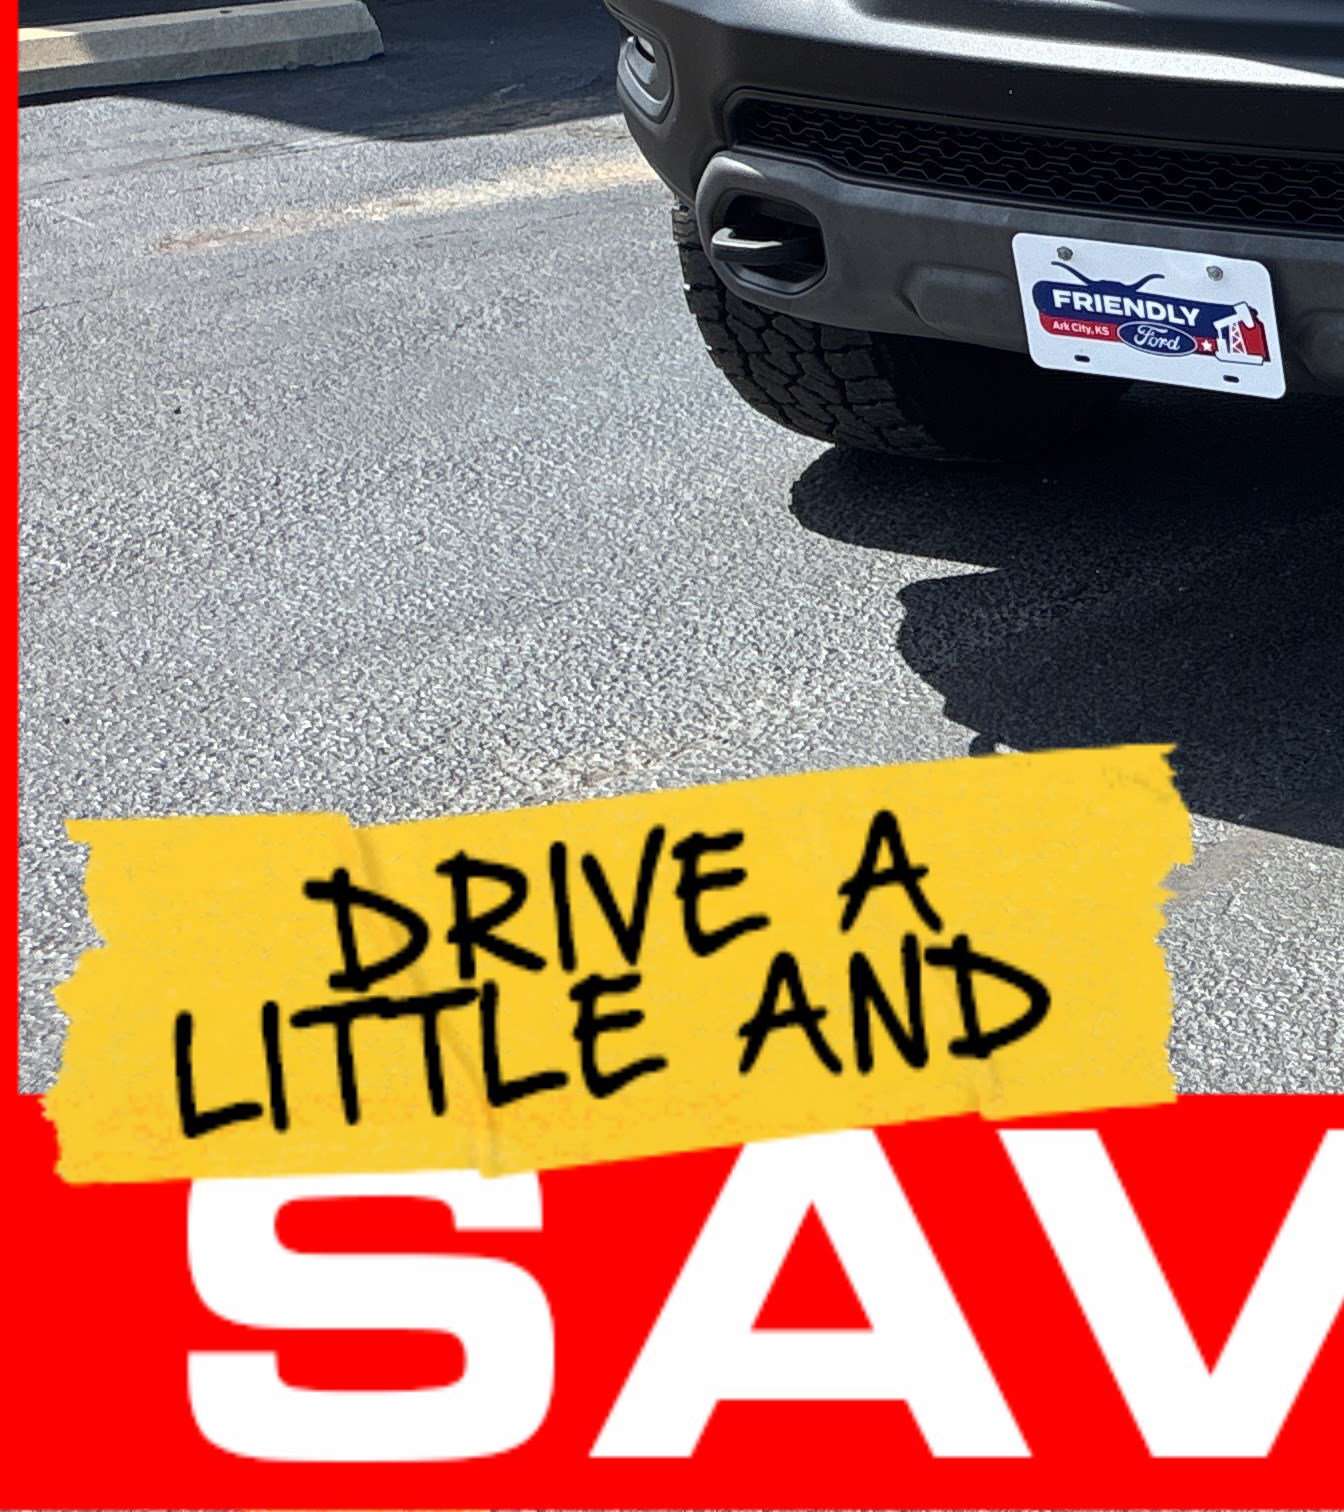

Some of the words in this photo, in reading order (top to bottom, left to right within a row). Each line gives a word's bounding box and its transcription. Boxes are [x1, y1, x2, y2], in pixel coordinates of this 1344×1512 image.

[1052, 288, 1200, 327] FRIENDLY
[1053, 320, 1071, 332] Ark
[1094, 325, 1110, 336] KS
[1133, 324, 1181, 351] Ford
